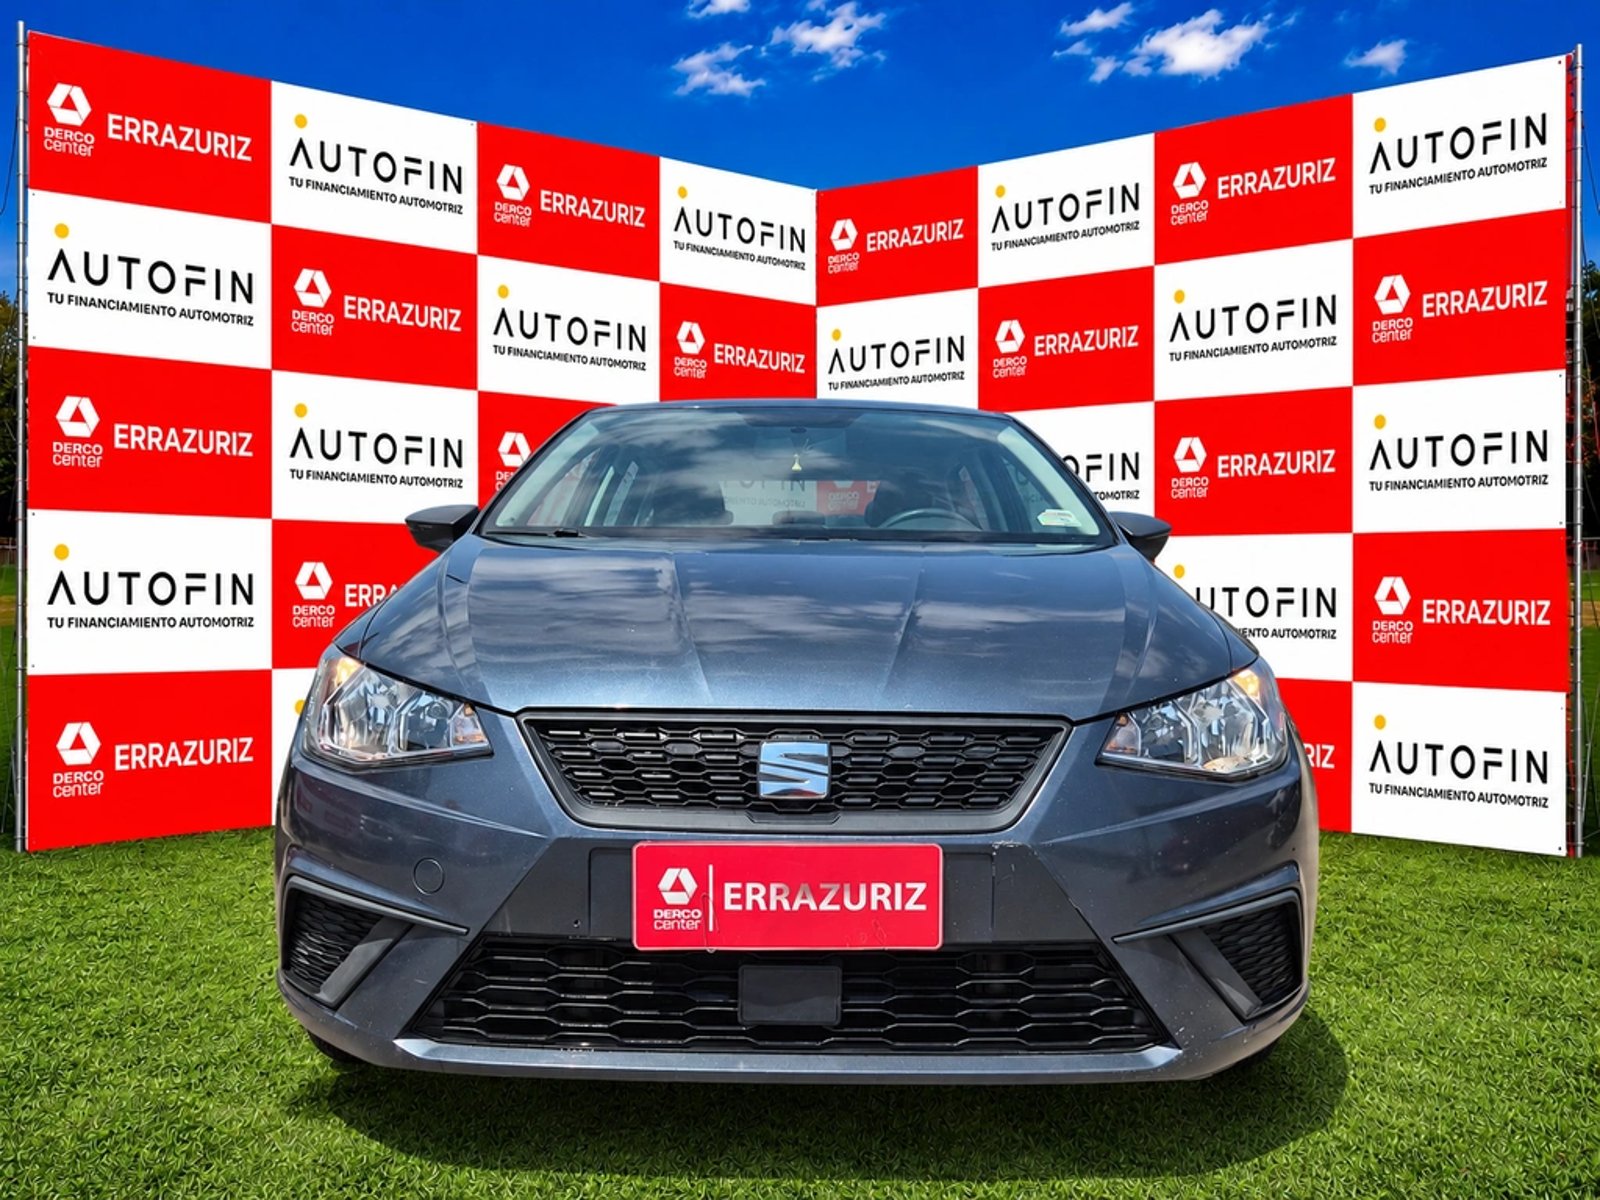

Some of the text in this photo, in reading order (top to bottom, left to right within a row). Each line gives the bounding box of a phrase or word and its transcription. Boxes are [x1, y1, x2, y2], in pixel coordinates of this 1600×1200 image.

[44, 127, 95, 144] DERCO
[108, 114, 251, 161] ERRAZURIZ
[1370, 113, 1546, 174] AUTOFIN
[44, 138, 93, 156] center
[290, 137, 462, 194] AUTOFIN
[1369, 157, 1547, 194] TU FINANCIAMIENTO AUTOMOTRIZ
[1218, 158, 1335, 199] ERRAZURIZ
[289, 176, 463, 215] TU FINANCIAMIENTO AUTOMOTRIZ
[495, 202, 532, 216] DERCO
[541, 190, 645, 227] ERRAZURIZ
[992, 182, 1139, 233] AUTOFIN
[1171, 200, 1208, 214] DERCO
[1171, 211, 1208, 225] center
[494, 212, 530, 226] center
[674, 207, 805, 253] AUTOFIN
[867, 219, 963, 252] ERRAZURIZ
[992, 221, 1139, 251] TU FINANCIAMIENTO AUTOMOTRIZ
[674, 240, 805, 270] TU FINANCIAMIENTO AUTOMOTRIZ
[828, 253, 859, 265] DERCO
[48, 248, 253, 304] AUTOFIN
[829, 261, 858, 273] center
[47, 292, 253, 326] TU FINANCIAMIENTO AUTOMOTRIZ
[1423, 281, 1547, 318] ERRAZURIZ
[292, 310, 334, 324] DERCO
[344, 295, 461, 331] ERRAZURIZ
[1170, 294, 1336, 342] AUTOFIN
[1373, 317, 1413, 331] DERCO
[292, 321, 333, 335] center
[493, 308, 646, 352] AUTOFIN
[1373, 329, 1412, 343] center
[1035, 325, 1138, 356] ERRAZURIZ
[1169, 336, 1337, 361] TU FINANCIAMIENTO AUTOMOTRIZ
[493, 345, 646, 371] TU FINANCIAMIENTO AUTOMOTRIZ
[675, 357, 707, 369] DERCO
[714, 343, 805, 373] ERRAZURIZ
[828, 335, 964, 374] AUTOFIN
[993, 356, 1027, 367] DERCO
[675, 367, 706, 378] center
[828, 371, 964, 390] TU FINANCIAMIENTO AUTOMOTRIZ
[993, 366, 1026, 378] center
[53, 442, 103, 455] DERCO
[114, 424, 253, 456] ERRAZURIZ
[290, 427, 462, 468] AUTOFIN
[1370, 429, 1547, 470] AUTOFIN
[53, 454, 102, 467] center
[1218, 449, 1335, 478] ERRAZURIZ
[290, 469, 463, 488] TU FINANCIAMIENTO AUTOMOTRIZ
[1172, 477, 1209, 488] DERCO
[1369, 474, 1548, 491] TU FINANCIAMIENTO AUTOMOTRIZ
[1172, 487, 1208, 498] center
[47, 571, 253, 606] AUTOFIN
[293, 605, 335, 616] DERCO
[293, 616, 334, 627] center
[1423, 599, 1550, 625] ERRAZURIZ
[47, 617, 254, 628] TU FINANCIAMIENTO AUTOMOTRIZ
[1271, 628, 1337, 639] AUTOMOTRIZ
[1373, 621, 1413, 631] DERCO
[1373, 631, 1412, 643] center
[115, 737, 253, 770] ERRAZURIZ
[1369, 740, 1547, 784] AUTOFIN
[53, 770, 104, 784] DERCO
[53, 782, 103, 797] center
[1369, 783, 1548, 808] TU FINANCIAMIENTO AUTOMOTRIZ
[724, 882, 927, 911] ERRAZURIZ
[654, 909, 702, 919] DERCO
[654, 919, 701, 930] center
